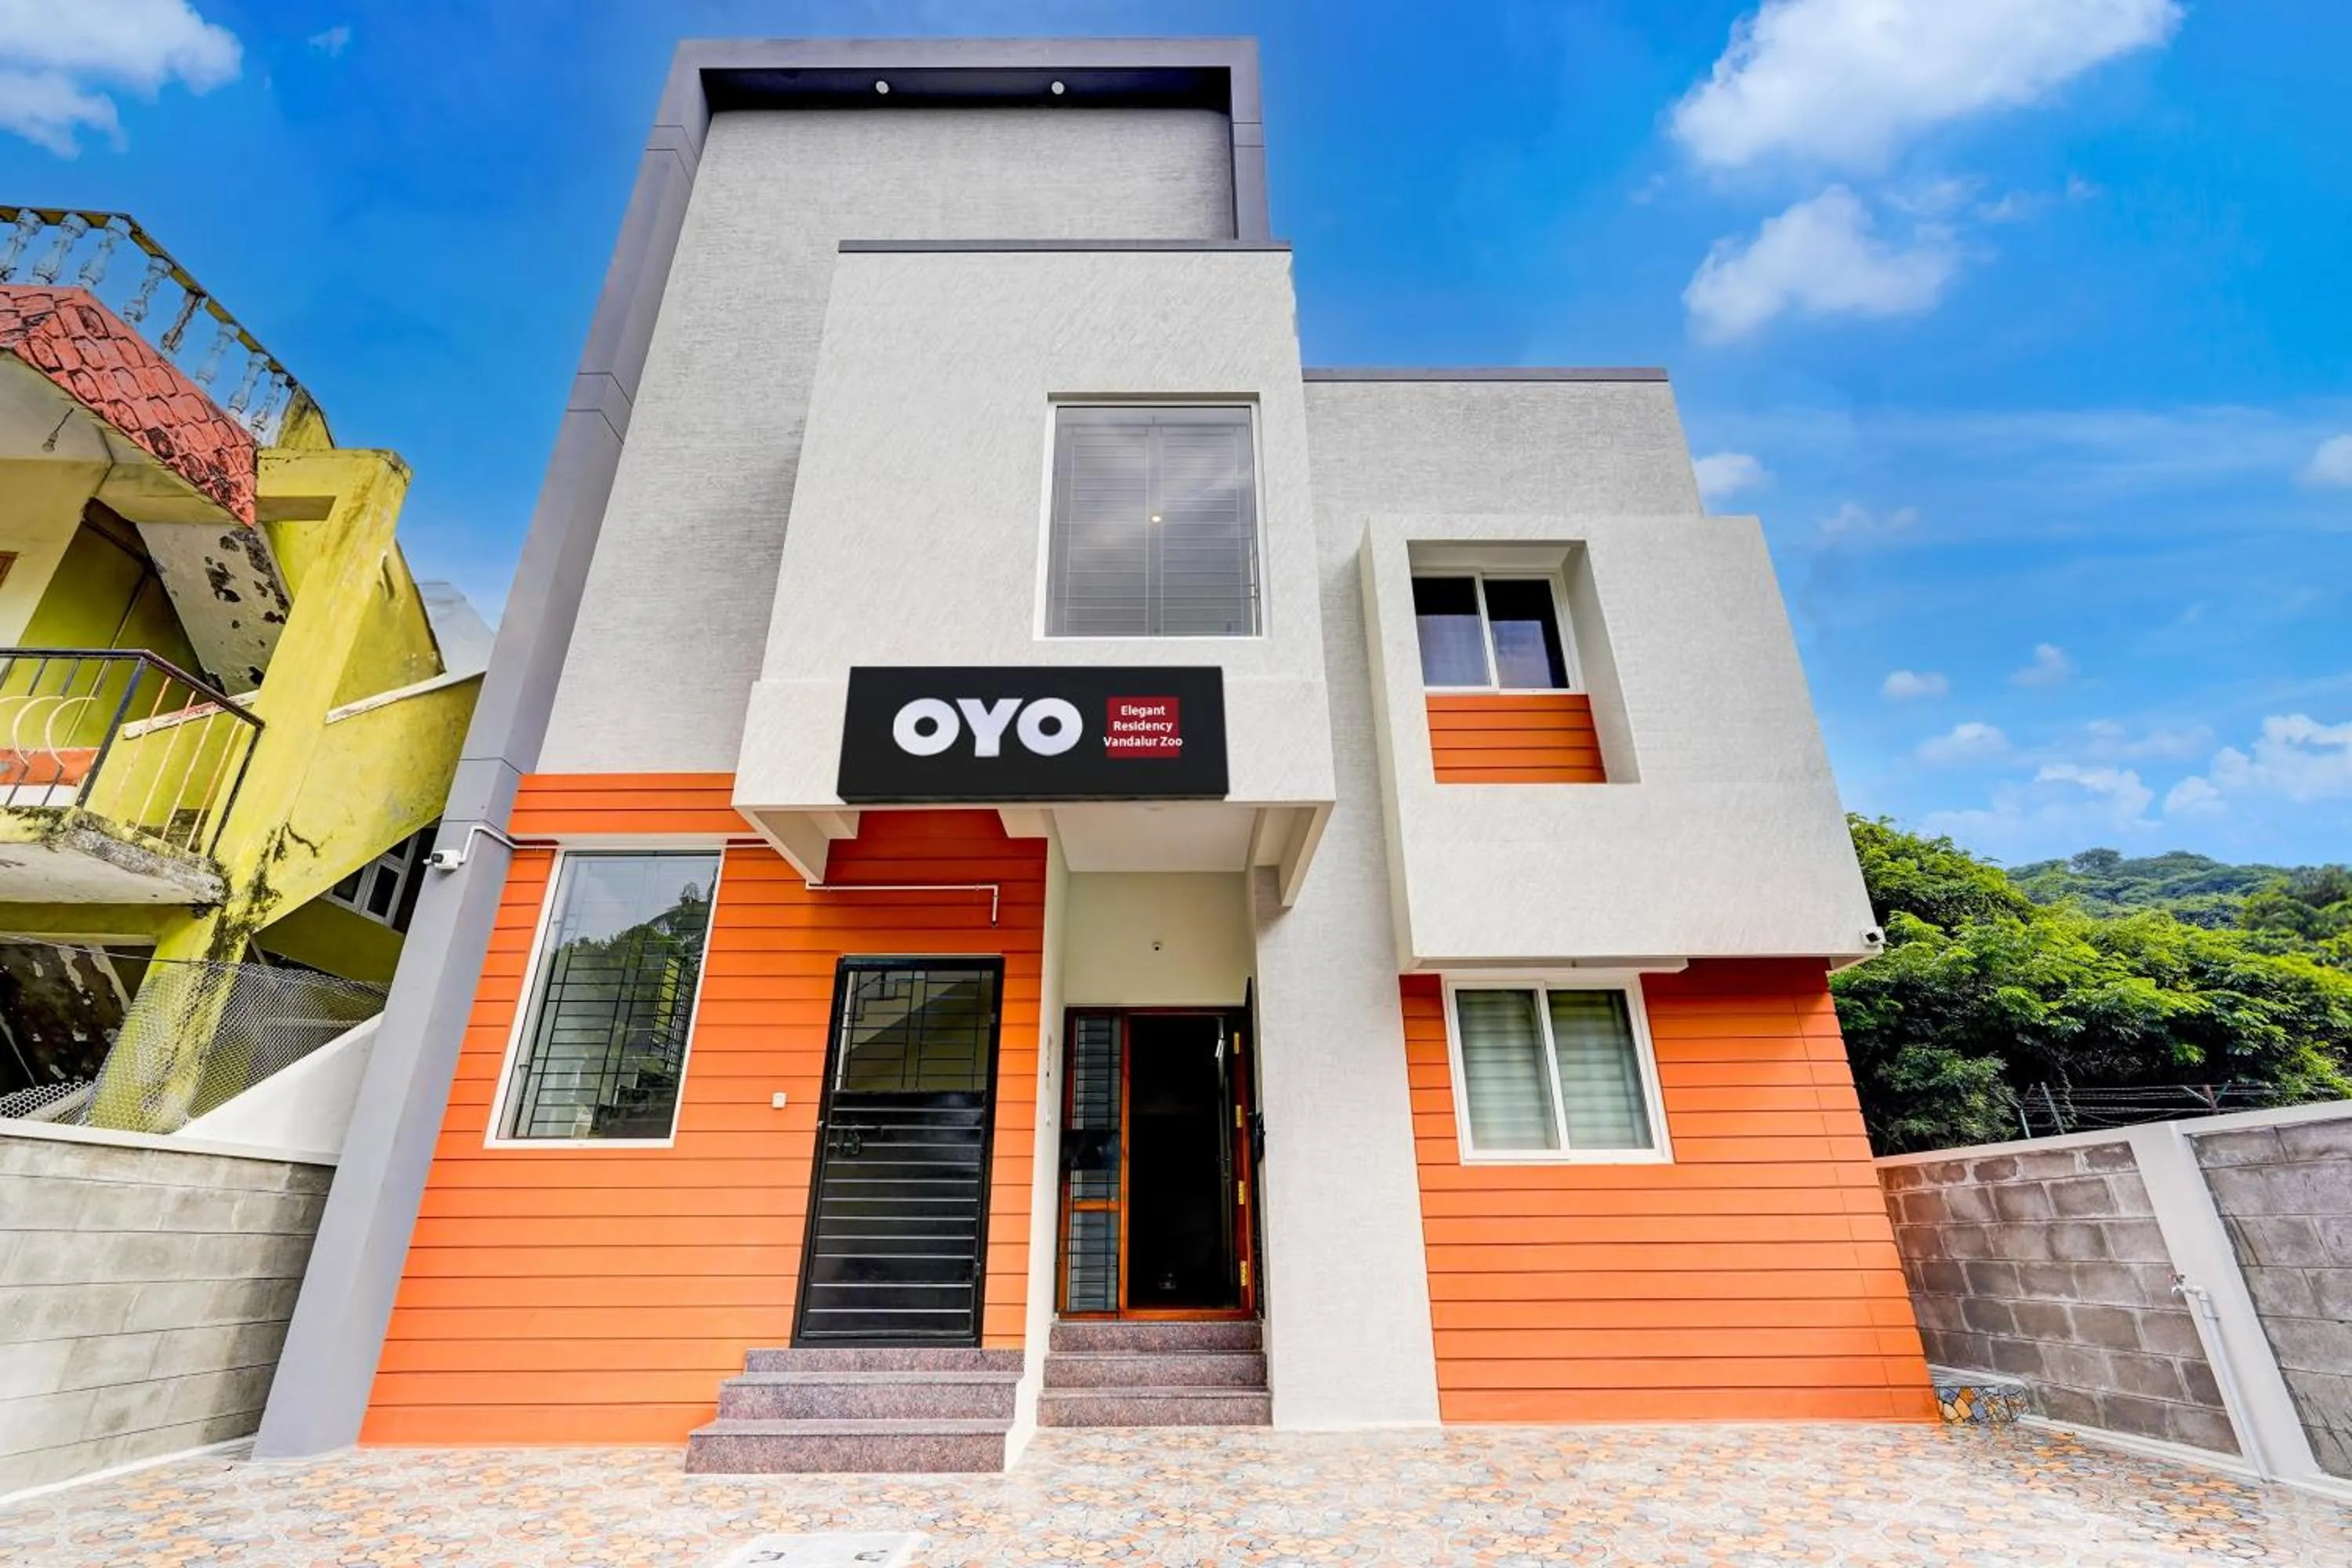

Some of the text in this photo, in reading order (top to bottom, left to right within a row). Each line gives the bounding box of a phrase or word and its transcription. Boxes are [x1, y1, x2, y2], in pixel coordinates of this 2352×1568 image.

[1120, 705, 1166, 717] Elegant
[893, 697, 1083, 757] OYO
[1113, 720, 1173, 732] Residency
[1103, 736, 1183, 746] Vandalur Zoo
